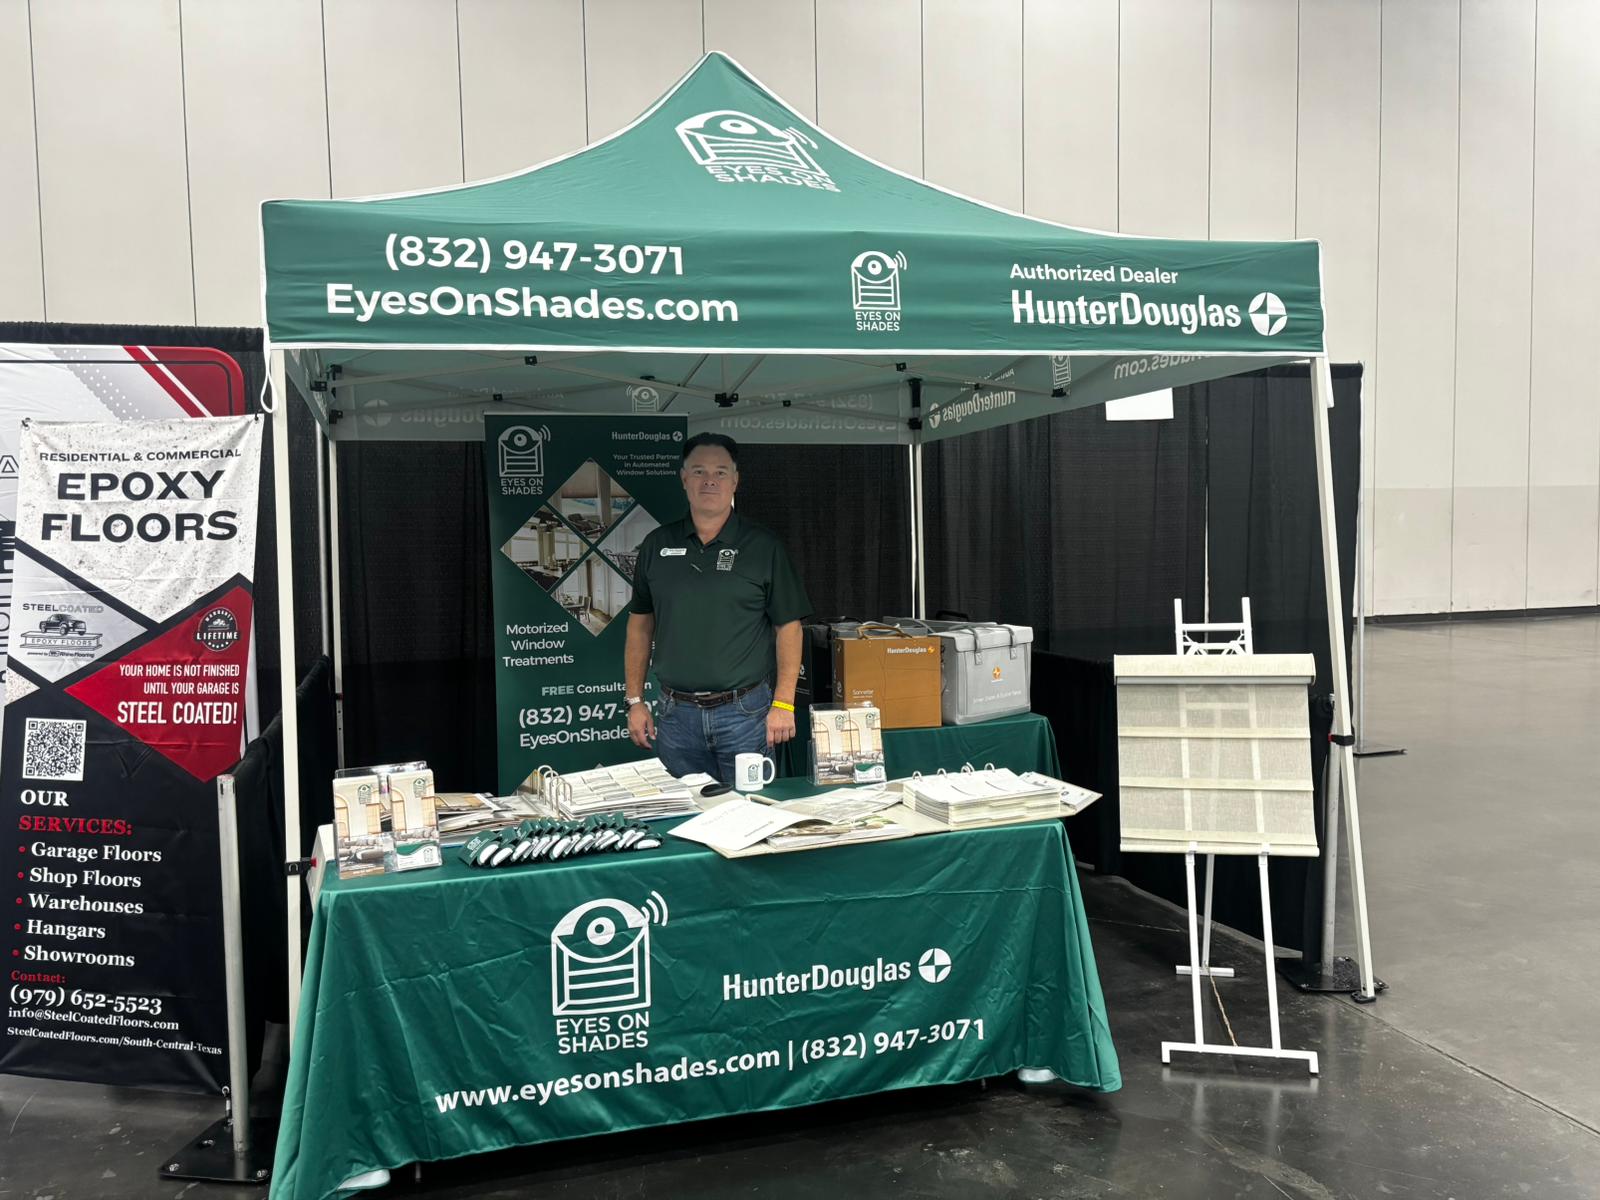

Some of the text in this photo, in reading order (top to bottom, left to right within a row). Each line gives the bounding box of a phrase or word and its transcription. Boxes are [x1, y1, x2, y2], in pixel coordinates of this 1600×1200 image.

[705, 165, 836, 185] EYES ON
[714, 173, 842, 193] SHADES
[384, 233, 684, 276] (832) 947-3071
[1010, 262, 1178, 285] Authorized Dealer
[326, 282, 740, 323] EyesOnShades.com
[1011, 289, 1242, 335] HunterDouglas
[855, 311, 901, 321] EYES ON
[856, 321, 901, 332] SHADES
[611, 431, 671, 442] HunterDouglas
[39, 449, 242, 463] RESIDENTIAL & COMMERCIAL
[57, 470, 226, 501] EPOXY
[500, 477, 544, 487] EYES ON
[501, 486, 544, 495] SHADES
[41, 510, 238, 543] FLOORS
[196, 631, 238, 640] LIFETIME
[506, 622, 569, 635] Motorized
[511, 639, 565, 651] Window
[119, 664, 240, 677] YOUR HOME IS NOT FINISHED
[502, 653, 574, 668] Treatments
[143, 682, 239, 694] UNTIL YOUR GARAGE IS
[541, 684, 574, 696] FREE
[117, 701, 238, 725] STEEL COATED!
[519, 705, 573, 728] (832)
[20, 789, 69, 807] OUR
[18, 815, 133, 836] SERVICES:
[31, 841, 162, 863] Garage Floors
[29, 867, 142, 888] Shop Floors
[28, 893, 144, 915] Warehouses
[26, 919, 106, 941] Hangars
[24, 944, 136, 967] Showrooms
[10, 970, 67, 984] Contact:
[722, 959, 911, 1001] HunterDouglas
[10, 984, 163, 1016] (979) 652-5523
[8, 1006, 180, 1031] info@SteelCoatedFloors.com
[556, 1011, 650, 1036] EYES ON
[7, 1026, 223, 1055] SteelCoatedFloors.com/South-Central-Texas
[558, 1030, 649, 1055] SHADES
[434, 1046, 780, 1113] www.eyesonshades.com
[800, 1030, 867, 1065] (832)
[873, 1018, 986, 1054] 947-3071
